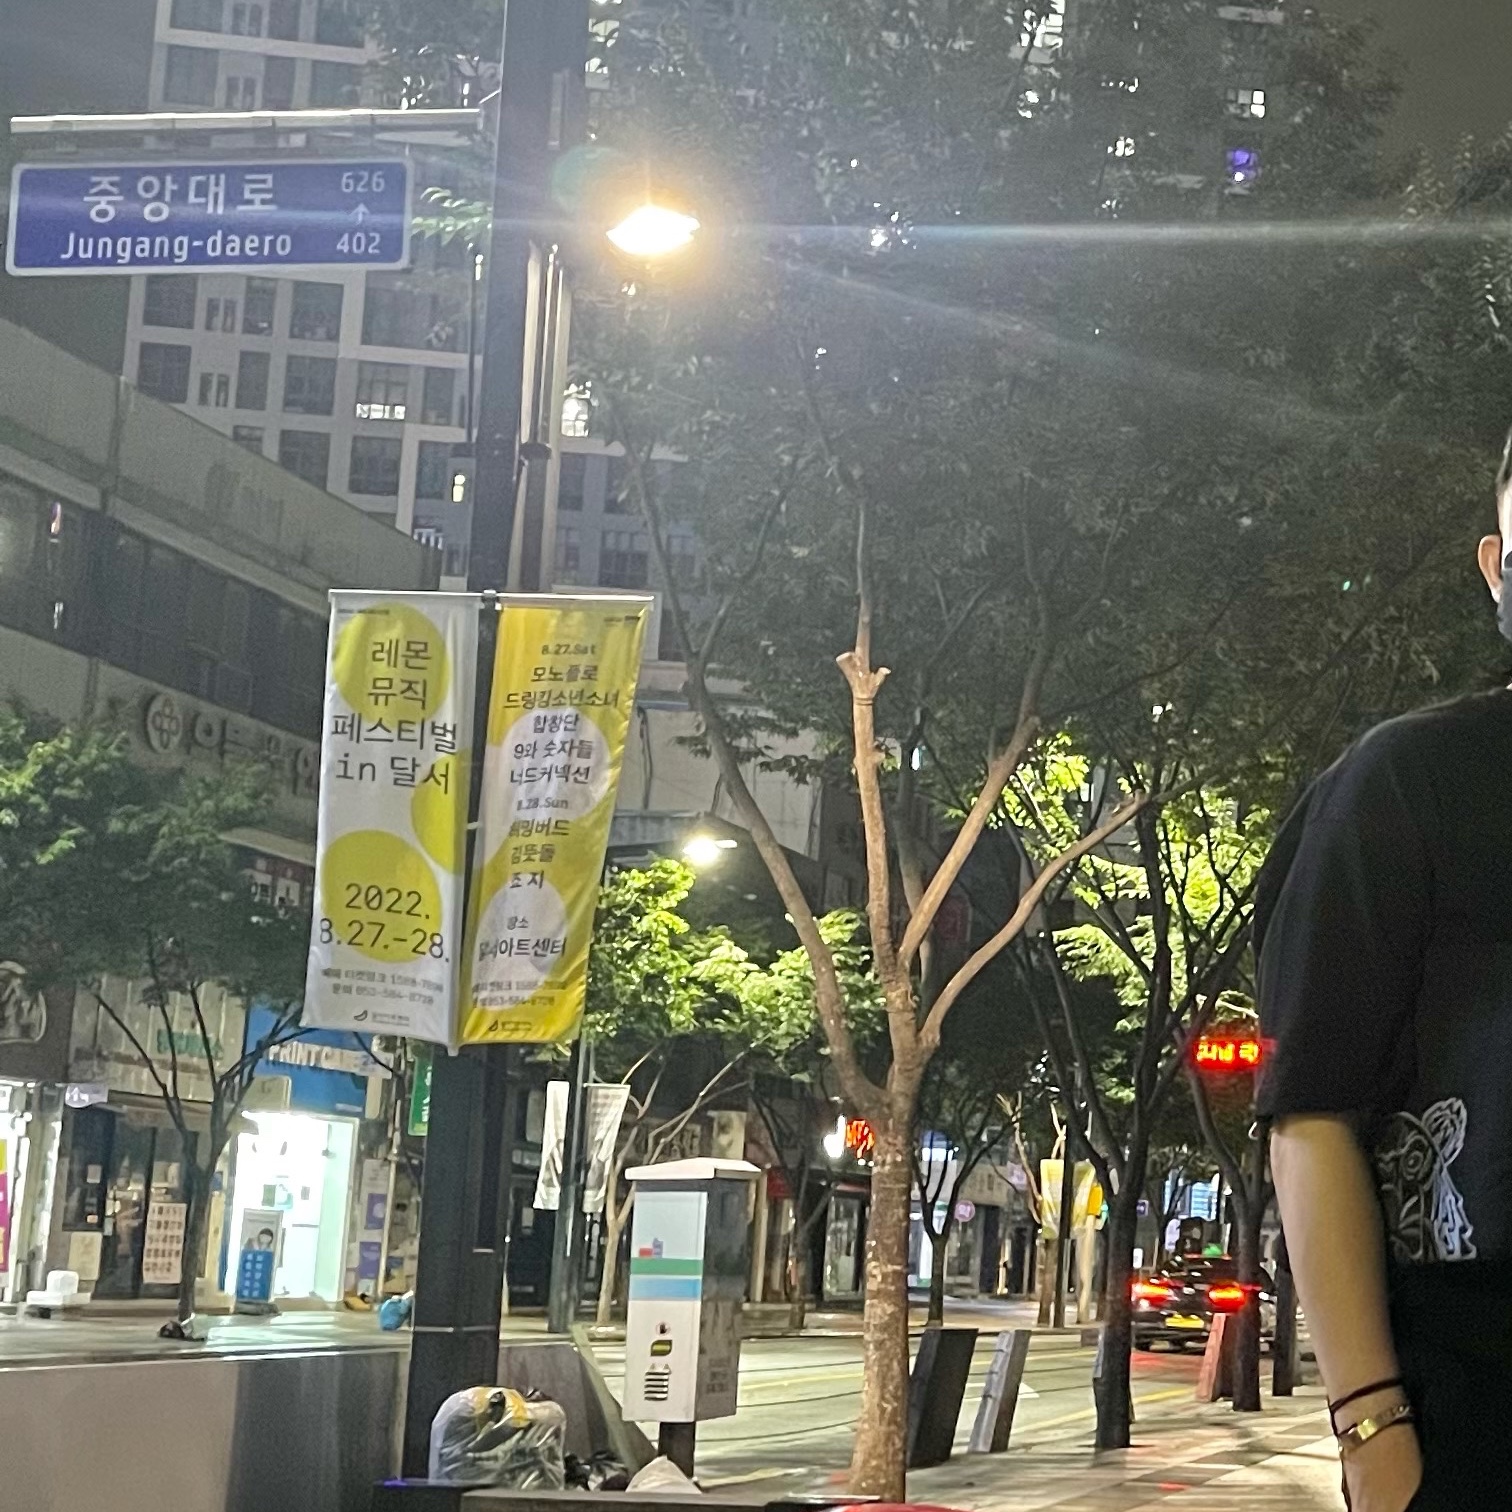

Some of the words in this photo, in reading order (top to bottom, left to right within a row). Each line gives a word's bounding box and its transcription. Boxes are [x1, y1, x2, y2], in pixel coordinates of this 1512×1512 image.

[83, 174, 278, 223] 중앙대로
[340, 171, 385, 193] 626
[60, 230, 292, 264] Jungang-daero
[336, 232, 381, 255] 402
[371, 639, 432, 670] 레몬
[367, 678, 428, 711] 뮤직
[331, 712, 458, 755] 페스티벌
[336, 753, 377, 781] in
[389, 756, 450, 796] 달서
[345, 883, 431, 920] 2022.
[319, 917, 450, 963] 8.27.-28.
